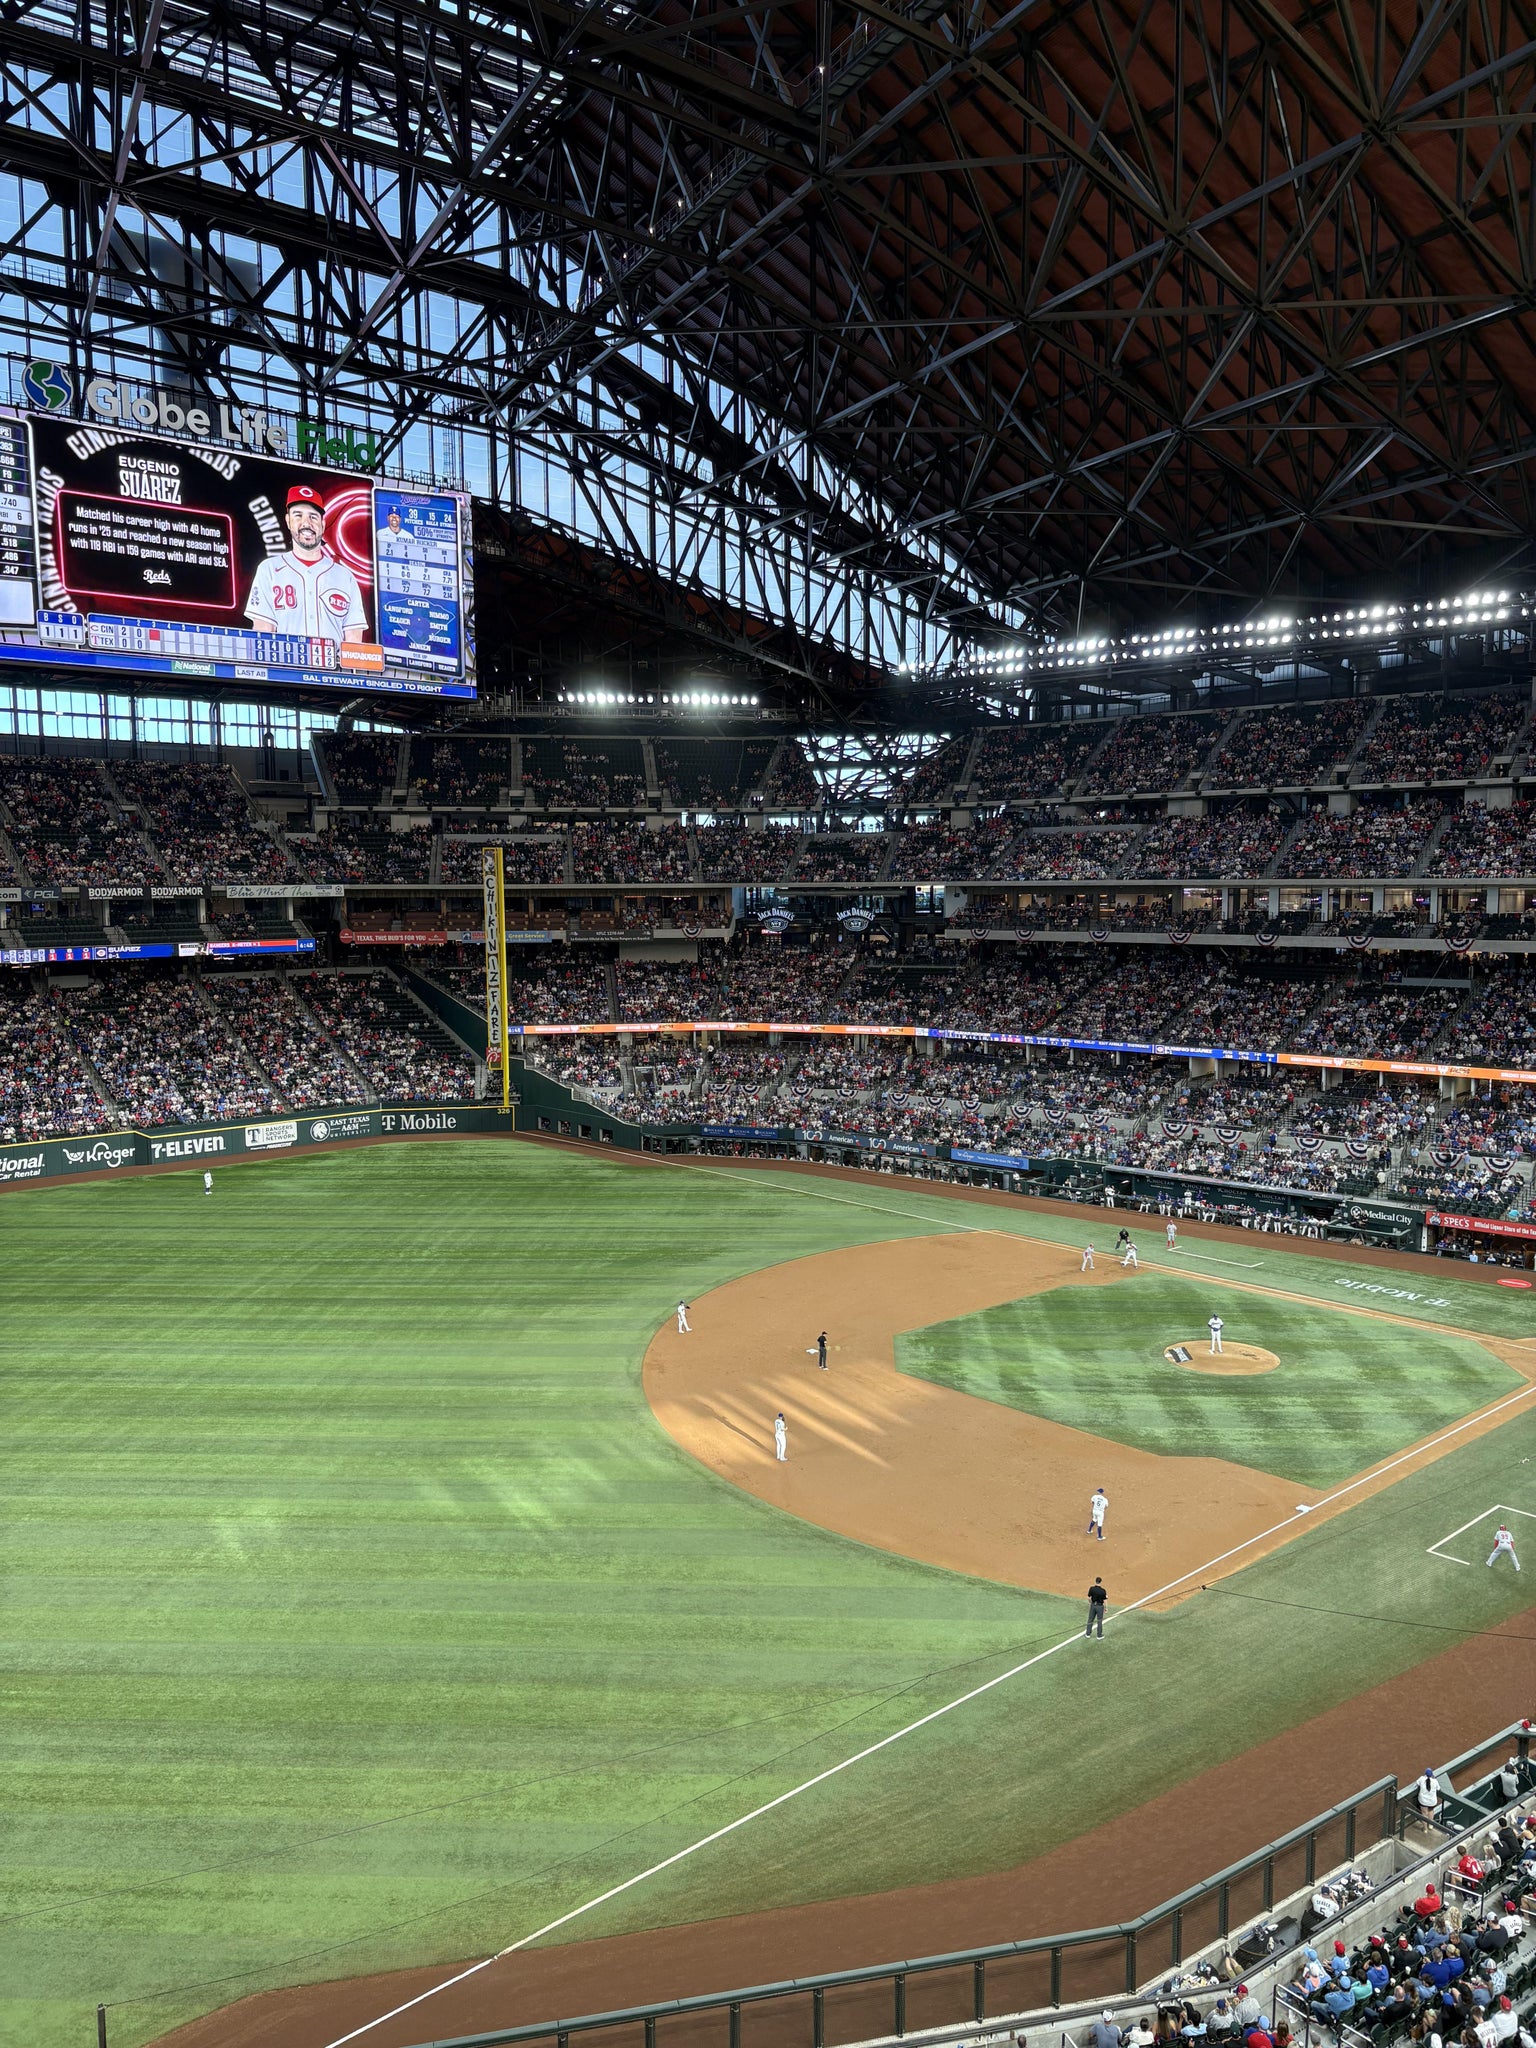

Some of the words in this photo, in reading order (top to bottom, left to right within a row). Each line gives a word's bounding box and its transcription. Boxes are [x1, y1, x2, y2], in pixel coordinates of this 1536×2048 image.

[87, 378, 211, 437] Globe
[220, 404, 289, 450] Life
[296, 417, 377, 468] Field
[119, 455, 180, 476] EUGENIO
[4, 484, 14, 493] 1B
[119, 469, 182, 505] SUÁREZ
[18, 512, 23, 520] 6
[409, 508, 418, 519] 39
[429, 512, 436, 522] 15
[444, 514, 452, 524] 24
[76, 506, 111, 523] Matched
[112, 512, 125, 525] his
[126, 515, 153, 528] career
[154, 518, 171, 532] high
[172, 522, 189, 534] with
[190, 523, 199, 535] 49
[200, 525, 221, 539] home
[417, 526, 434, 538] 50%
[69, 523, 89, 534] runs
[90, 524, 98, 535] in
[99, 526, 111, 537] '25
[113, 528, 128, 540] and
[129, 531, 161, 544] reached
[163, 537, 167, 545] a
[169, 537, 185, 548] new
[186, 540, 212, 552] season
[213, 542, 229, 555] high
[70, 538, 89, 550] with
[90, 540, 102, 551] 118
[103, 542, 116, 554] RBI
[117, 544, 125, 555] in
[127, 545, 140, 556] 159
[141, 548, 166, 560] games
[167, 551, 184, 563] with
[185, 553, 197, 564] ARI
[198, 556, 212, 567] and
[213, 557, 229, 569] SEA.
[143, 569, 172, 586] Reds
[273, 585, 297, 611] 28
[407, 600, 430, 609] CARTER
[44, 612, 49, 622] B
[58, 614, 63, 624] S
[71, 616, 77, 625] O
[45, 626, 51, 637] 1
[60, 627, 65, 638] 1
[74, 629, 79, 639] 1
[101, 626, 114, 637] CIN
[122, 626, 127, 637] 2
[136, 629, 142, 639] 0
[257, 640, 263, 650] 2
[272, 642, 277, 652] 4
[286, 643, 291, 653] 0
[300, 644, 305, 654] 3
[314, 646, 319, 656] 4
[328, 647, 333, 657] 2
[101, 637, 114, 648] TEX
[122, 638, 127, 648] 0
[138, 640, 143, 651] 0
[258, 651, 263, 661] 0
[272, 653, 277, 663] 3
[286, 654, 290, 664] 1
[300, 655, 305, 665] 3
[314, 657, 319, 667] 4
[328, 658, 333, 668] 2
[341, 650, 382, 662] WHATABURGER
[183, 662, 212, 674] National
[237, 668, 255, 678] LAST
[256, 670, 266, 679] AB
[303, 674, 320, 684] SAL
[322, 676, 365, 687] STEWART
[366, 680, 403, 690] SINGLED
[404, 683, 416, 692] TO
[417, 685, 443, 694] RIGHT
[88, 887, 144, 897] BODYARMOR
[151, 886, 204, 897] BODYARMOR
[228, 886, 255, 898] Blue
[257, 886, 289, 896] Mint
[290, 886, 314, 897] Thai
[757, 909, 773, 922] JACK
[836, 909, 852, 922] JACK
[405, 934, 414, 942] FOR
[330, 1118, 347, 1127] EAST
[348, 1116, 371, 1125] TEXAS
[341, 1123, 360, 1132] A&M
[400, 1113, 457, 1131] Mobile
[265, 1124, 293, 1133] RANGERS
[265, 1130, 289, 1138] SPORTS
[265, 1134, 296, 1142] NETWORK
[829, 1134, 854, 1144] American
[893, 1143, 919, 1153] American
[86, 1142, 136, 1168] Kroger
[14, 1168, 41, 1179] Rental
[1362, 1209, 1396, 1222] Medical
[1395, 1213, 1413, 1226] City
[1443, 1216, 1470, 1228] SPEC'S
[1334, 1278, 1426, 1301] Mobile
[1320, 1907, 1326, 1916] 5
